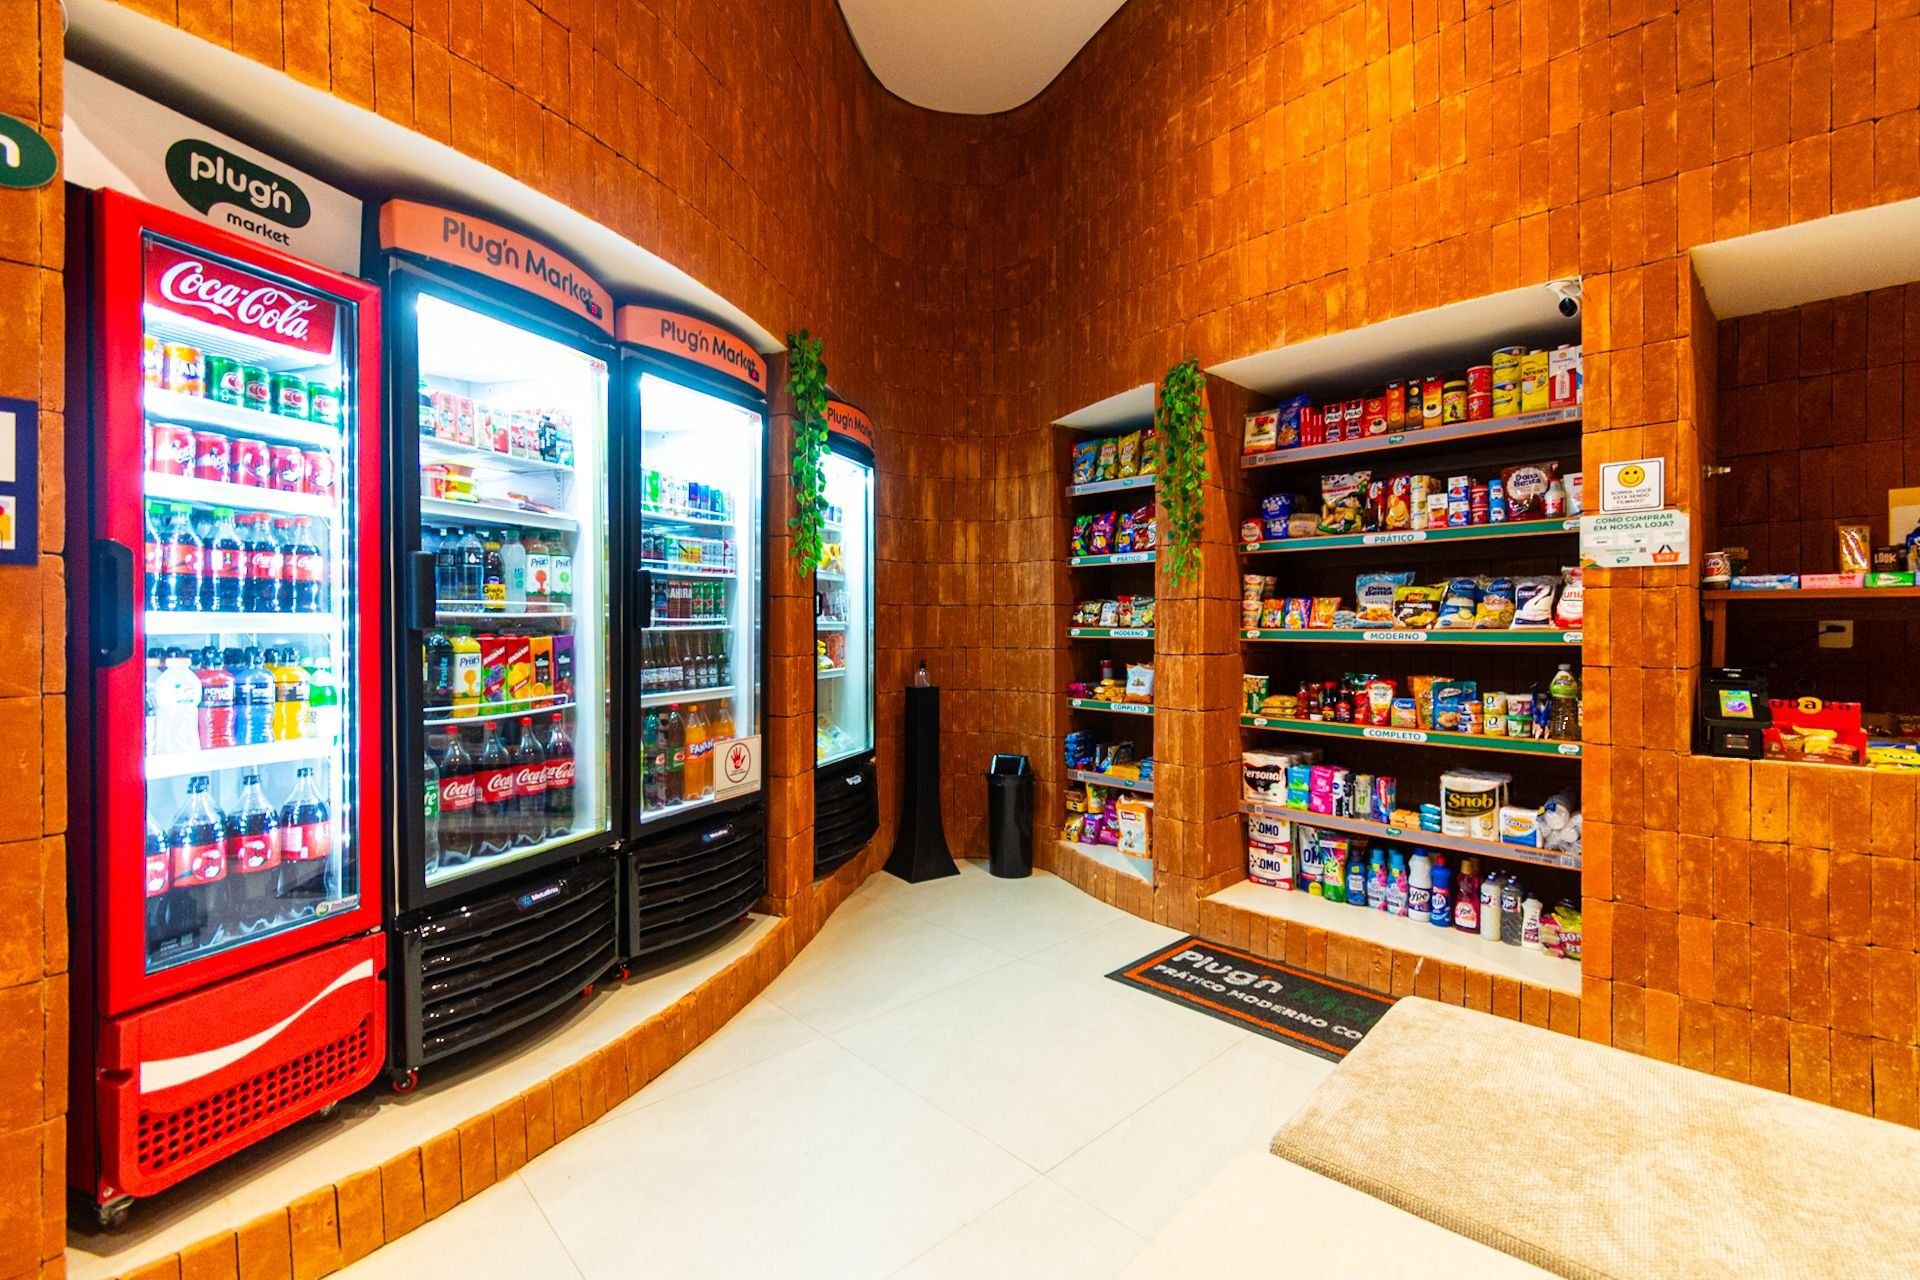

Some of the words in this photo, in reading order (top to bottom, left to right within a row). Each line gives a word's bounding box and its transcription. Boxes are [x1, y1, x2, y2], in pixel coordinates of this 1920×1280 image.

[226, 212, 290, 246] market
[442, 216, 520, 269] Plug'n
[525, 248, 594, 302] Market
[161, 261, 317, 341] Coca-Cola
[660, 318, 709, 352] Plug'n
[712, 335, 757, 371] Market
[590, 359, 605, 370] 220
[1513, 479, 1541, 488] Benta
[1514, 473, 1539, 481] Dona
[1625, 513, 1673, 522] COMPRAR
[1609, 522, 1642, 531] NOSSA
[1644, 520, 1674, 529] LOJA?
[1374, 533, 1414, 543] PRÁTICO
[1117, 554, 1141, 563] PRÁTICO
[1874, 552, 1897, 564] LOOK
[1370, 632, 1420, 640] MODERNO
[1113, 704, 1145, 712] COMPLETO
[1369, 729, 1421, 742] COMPLETO
[1243, 767, 1283, 781] Personal
[1447, 793, 1494, 809] Snob
[1258, 822, 1279, 837] OMO
[1259, 858, 1281, 873] OMO
[1172, 950, 1284, 994] Plug'n
[1152, 964, 1226, 992] PRÁTICO
[1227, 989, 1328, 1029] MODERNO
